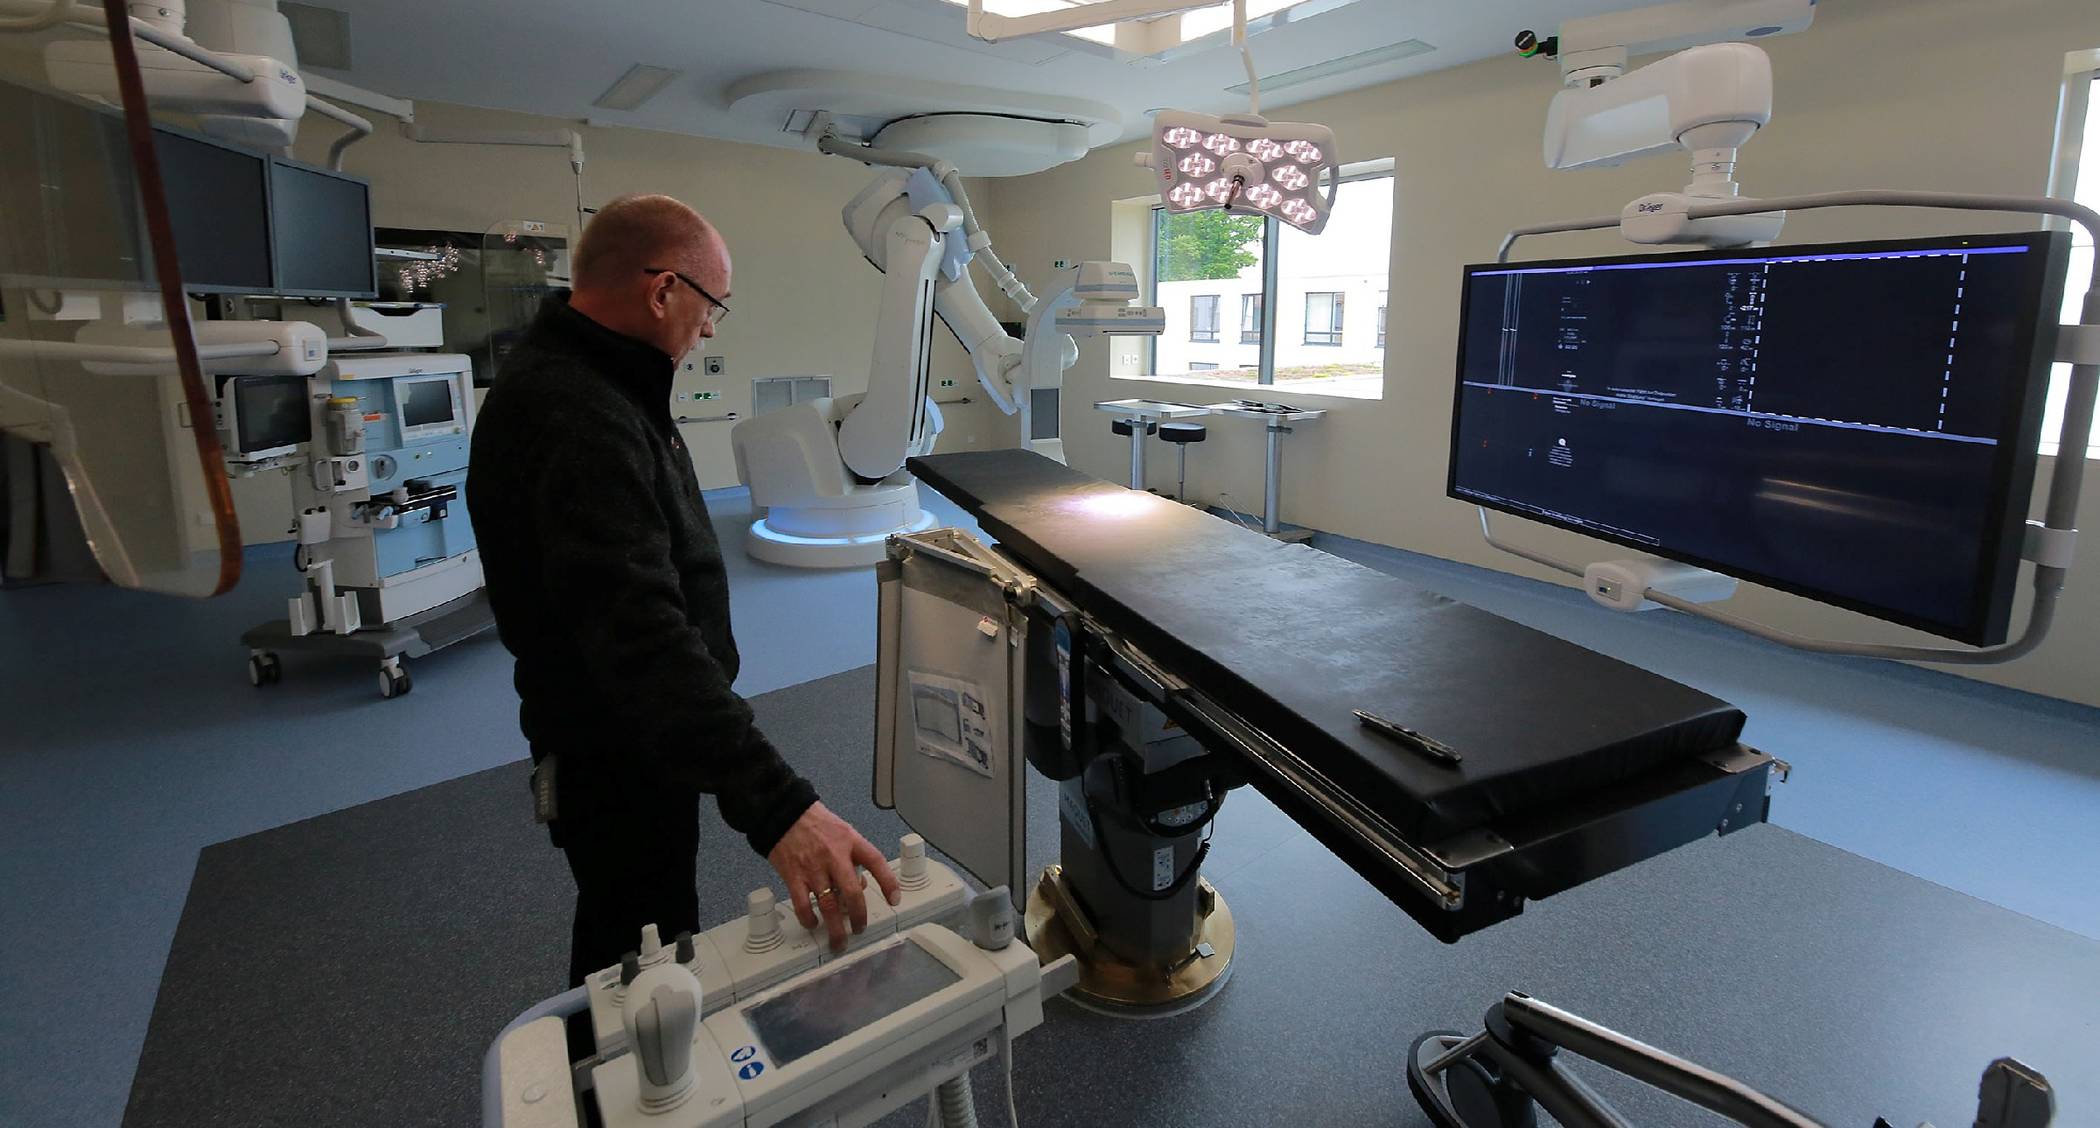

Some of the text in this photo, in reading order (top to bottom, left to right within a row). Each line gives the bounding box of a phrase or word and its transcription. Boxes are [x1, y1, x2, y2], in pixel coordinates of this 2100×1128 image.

[1591, 400, 1616, 409] Signal
[1746, 418, 1799, 431] No Signal
